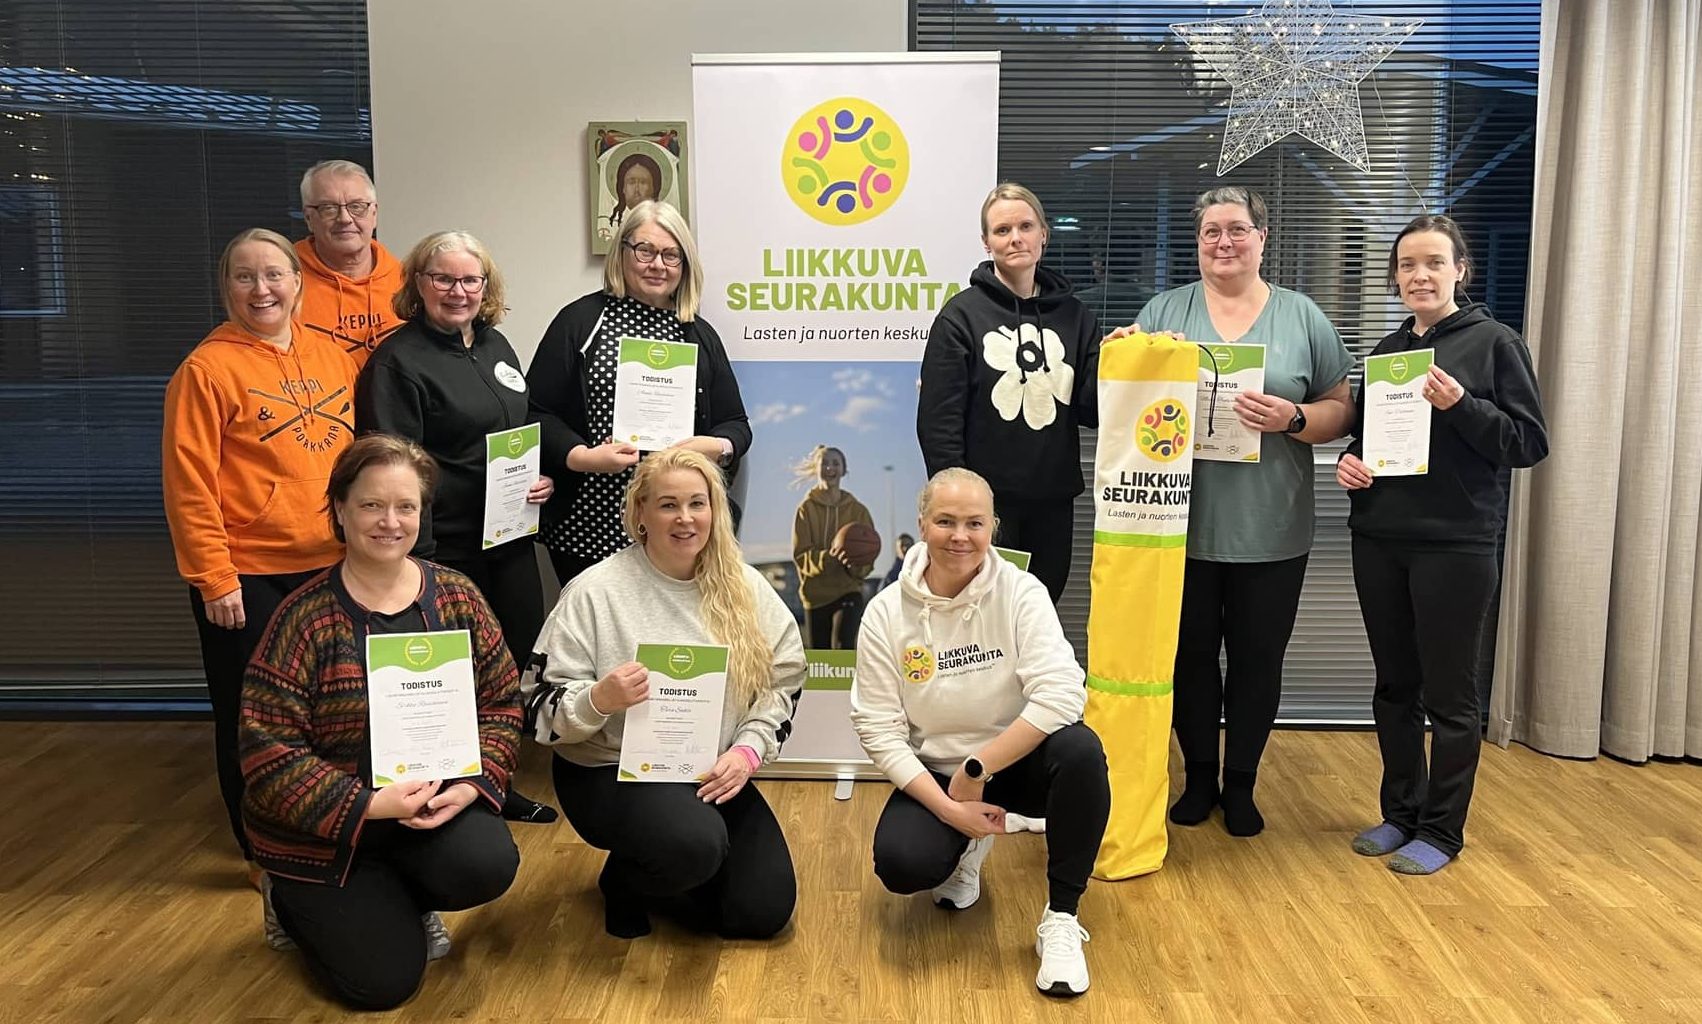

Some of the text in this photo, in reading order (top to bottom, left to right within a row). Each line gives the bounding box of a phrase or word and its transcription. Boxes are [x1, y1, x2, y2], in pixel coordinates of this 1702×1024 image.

[763, 248, 927, 277] LIIKKUVA
[743, 326, 929, 344] Lasten ja nuorten kesku
[279, 379, 324, 395] KEPPI
[1205, 381, 1238, 389] TOISTUS
[258, 406, 275, 420] &
[1120, 471, 1190, 488] LIIKKUVA
[1108, 508, 1136, 519] Lasten
[1138, 512, 1147, 520] ja
[938, 644, 980, 660] LIIKKUVA
[938, 649, 1003, 670] SEURAKUNTA
[809, 662, 857, 678] liikun
[400, 680, 443, 690] TODISTUS
[659, 688, 698, 697] TODISTUS
